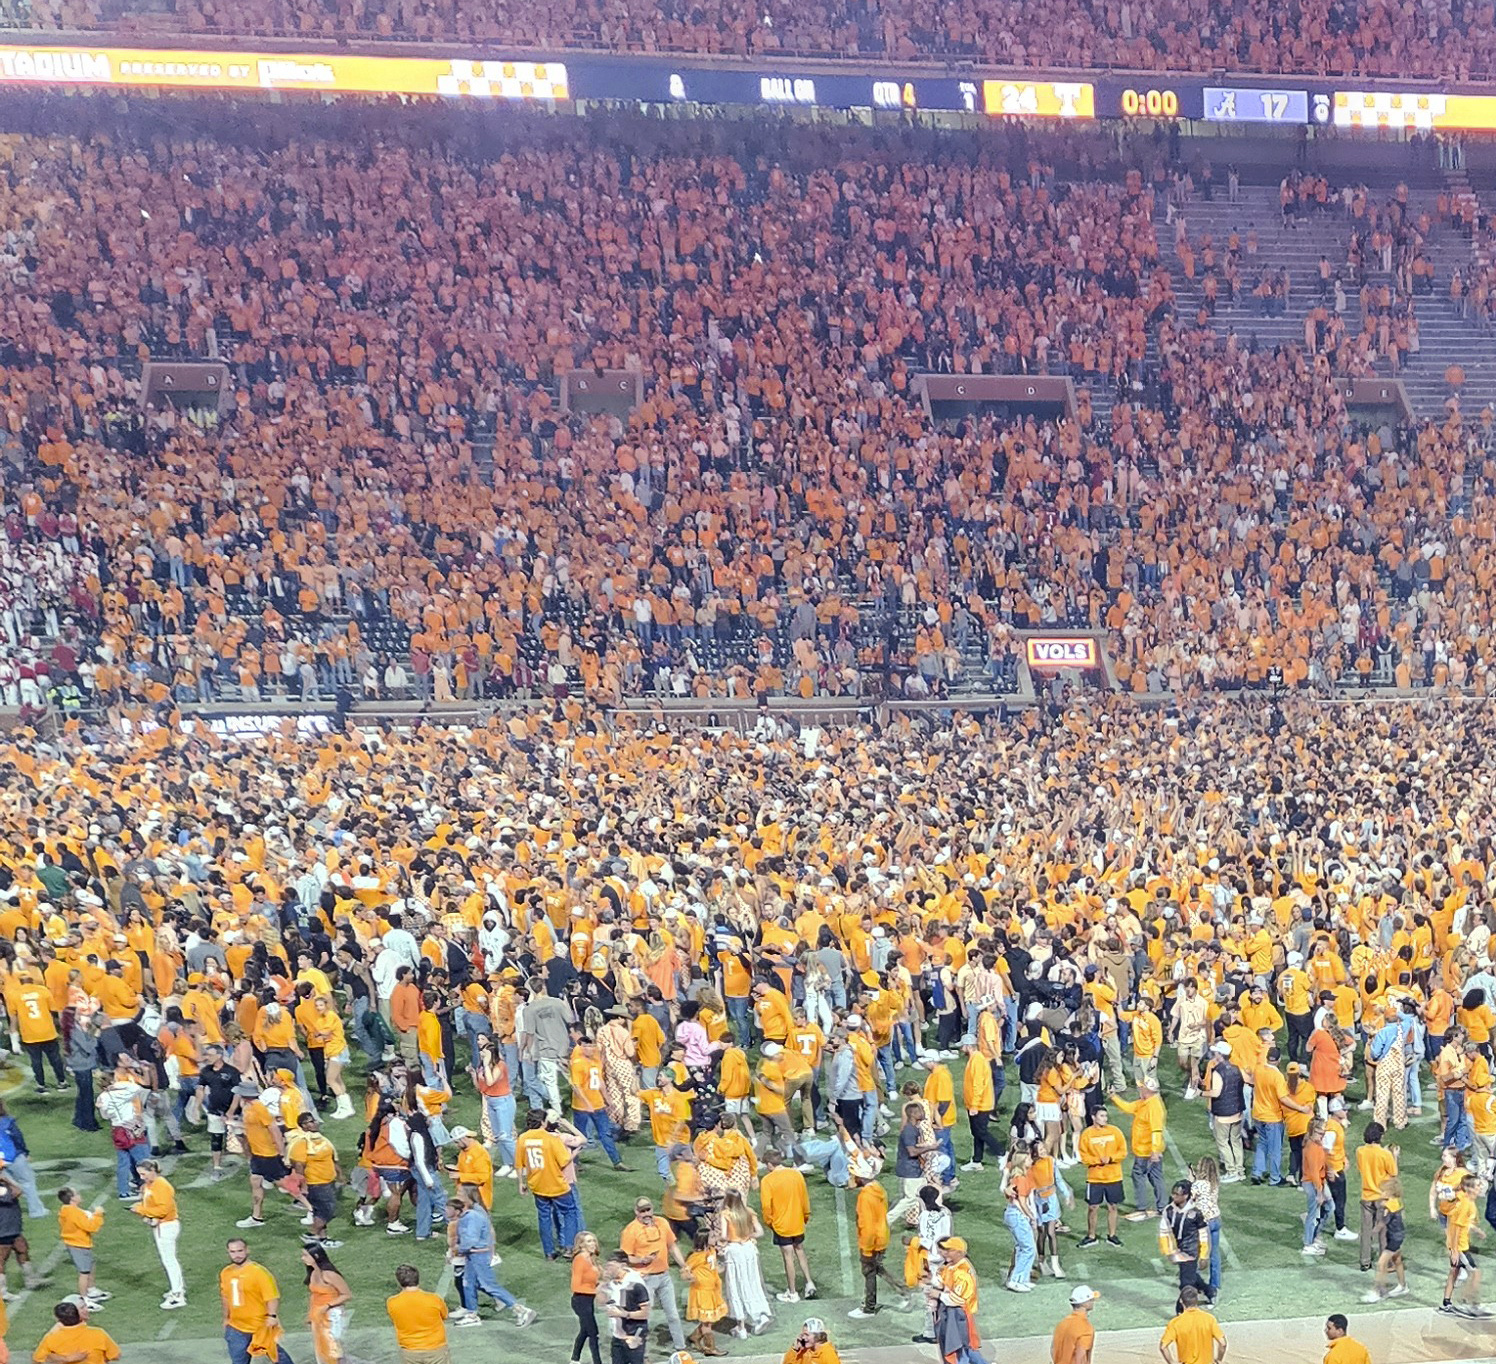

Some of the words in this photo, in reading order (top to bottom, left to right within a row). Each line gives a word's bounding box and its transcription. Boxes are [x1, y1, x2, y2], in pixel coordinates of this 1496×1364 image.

[0, 51, 111, 80] TADIUM
[903, 83, 914, 107] 4
[1001, 85, 1038, 113] 24
[1122, 89, 1178, 115] 0:00
[1258, 94, 1289, 118] 17
[1036, 643, 1088, 660] VOLS
[26, 1000, 41, 1019] 3
[797, 1034, 817, 1056] T
[590, 1067, 601, 1090] 6
[231, 1278, 241, 1307] 1
